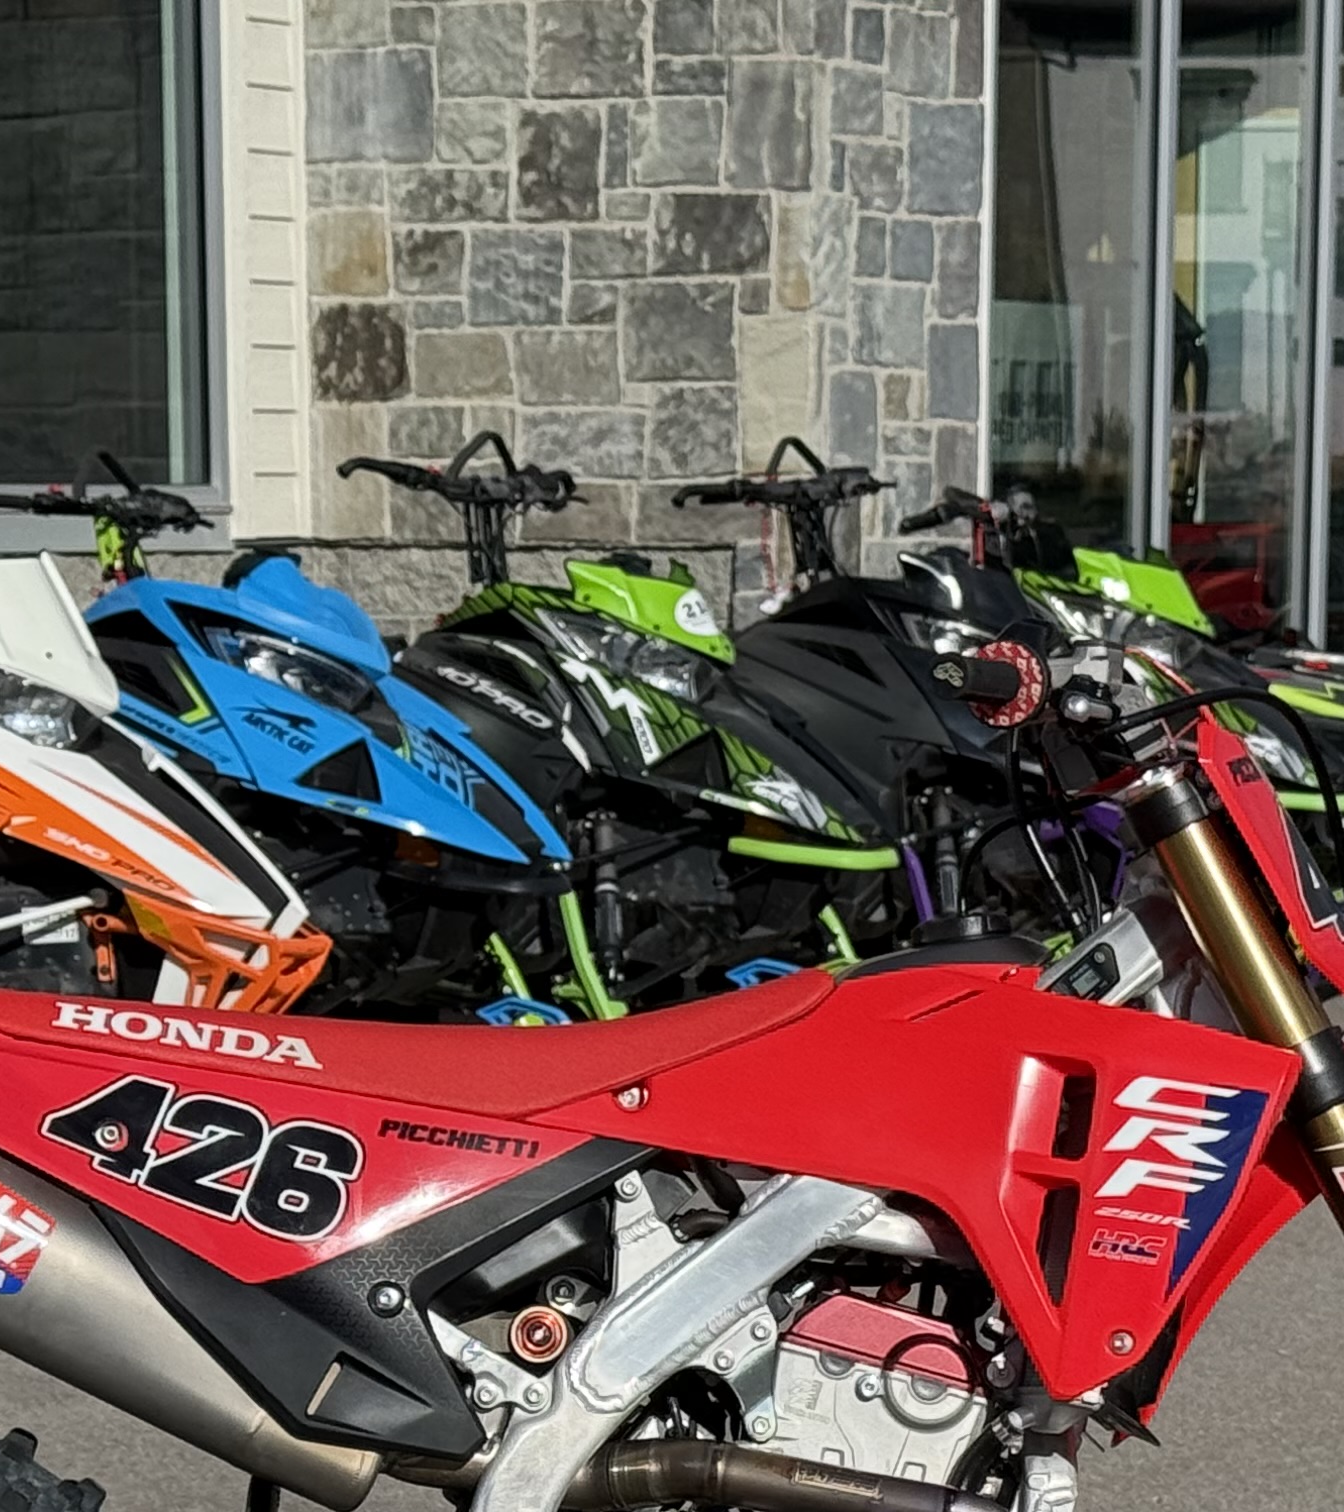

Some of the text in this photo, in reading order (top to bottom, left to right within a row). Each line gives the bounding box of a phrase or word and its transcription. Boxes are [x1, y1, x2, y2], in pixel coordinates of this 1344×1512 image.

[286, 735, 317, 755] CAT
[42, 826, 112, 863] SNO
[51, 1001, 324, 1070] HONDA
[377, 1118, 541, 1159] PICCHIETTI
[1093, 1075, 1242, 1198] CRF
[41, 1073, 366, 1243] 426
[1093, 1206, 1192, 1231] 250R
